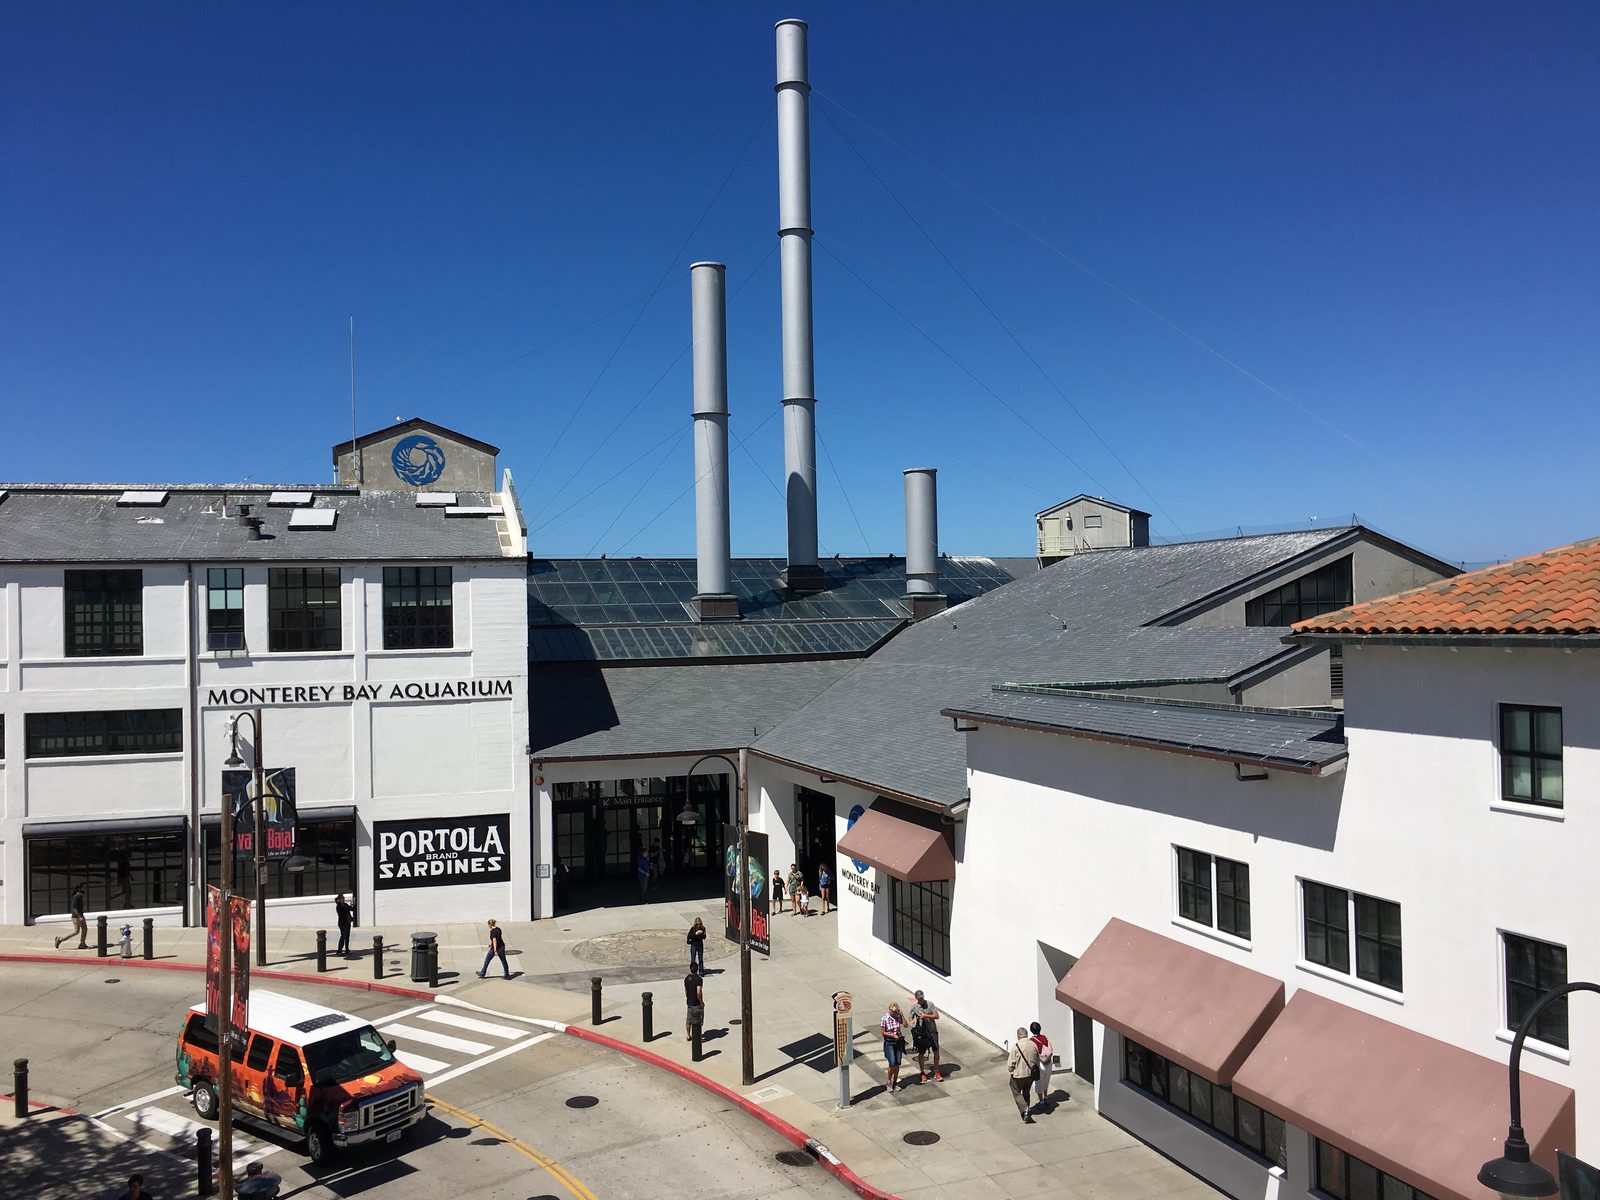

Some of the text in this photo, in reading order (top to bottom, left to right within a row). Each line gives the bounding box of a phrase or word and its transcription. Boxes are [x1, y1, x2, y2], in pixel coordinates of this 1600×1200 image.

[208, 680, 513, 706] MONTEREY BAY AQUARIUM
[267, 827, 295, 851] Baja!
[379, 825, 505, 863] PORTOLA
[379, 856, 502, 879] SARDINES
[426, 852, 458, 860] BRAND
[842, 868, 880, 895] MONTEREY BAY
[848, 883, 876, 904] AQUARIUM
